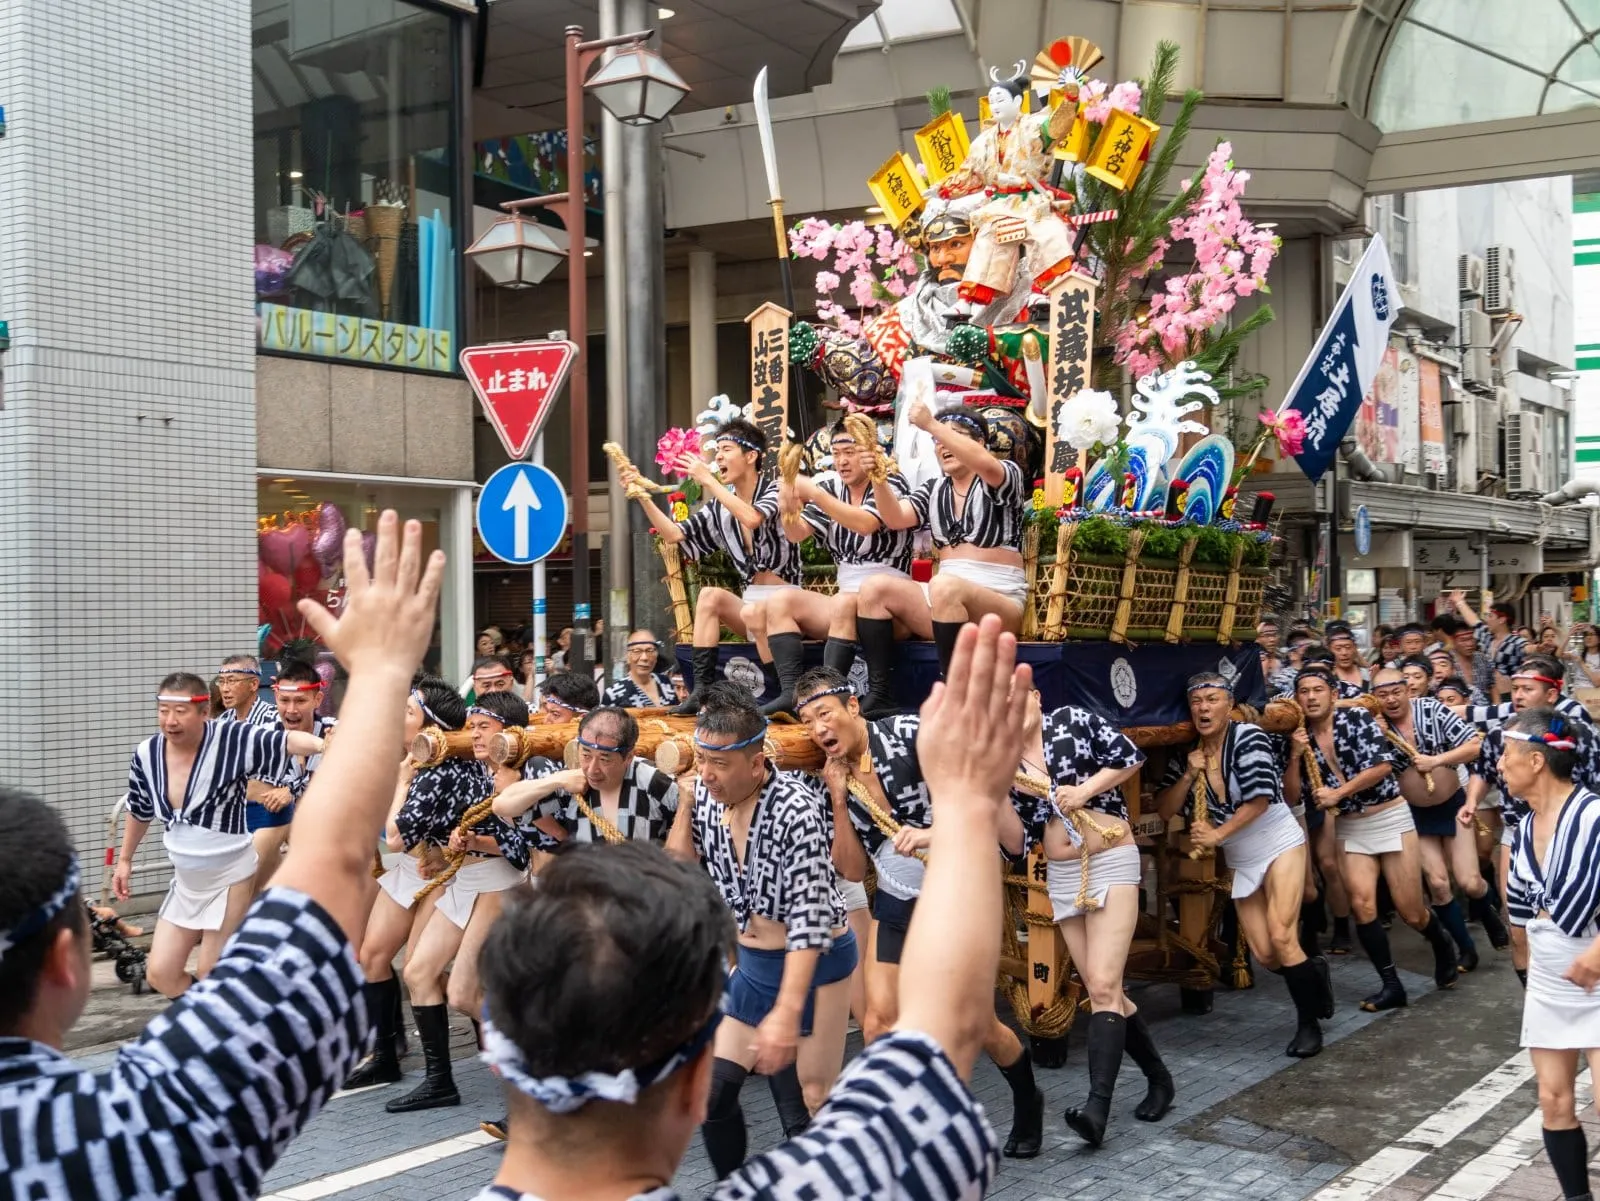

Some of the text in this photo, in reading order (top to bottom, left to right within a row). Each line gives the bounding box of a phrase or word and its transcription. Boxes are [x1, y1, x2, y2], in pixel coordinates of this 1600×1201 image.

[264, 311, 449, 368] バルーンスタンド
[754, 331, 768, 386] 山笠
[768, 328, 785, 384] 三番
[486, 367, 549, 394] 止まれ
[1304, 362, 1350, 451] 土居流
